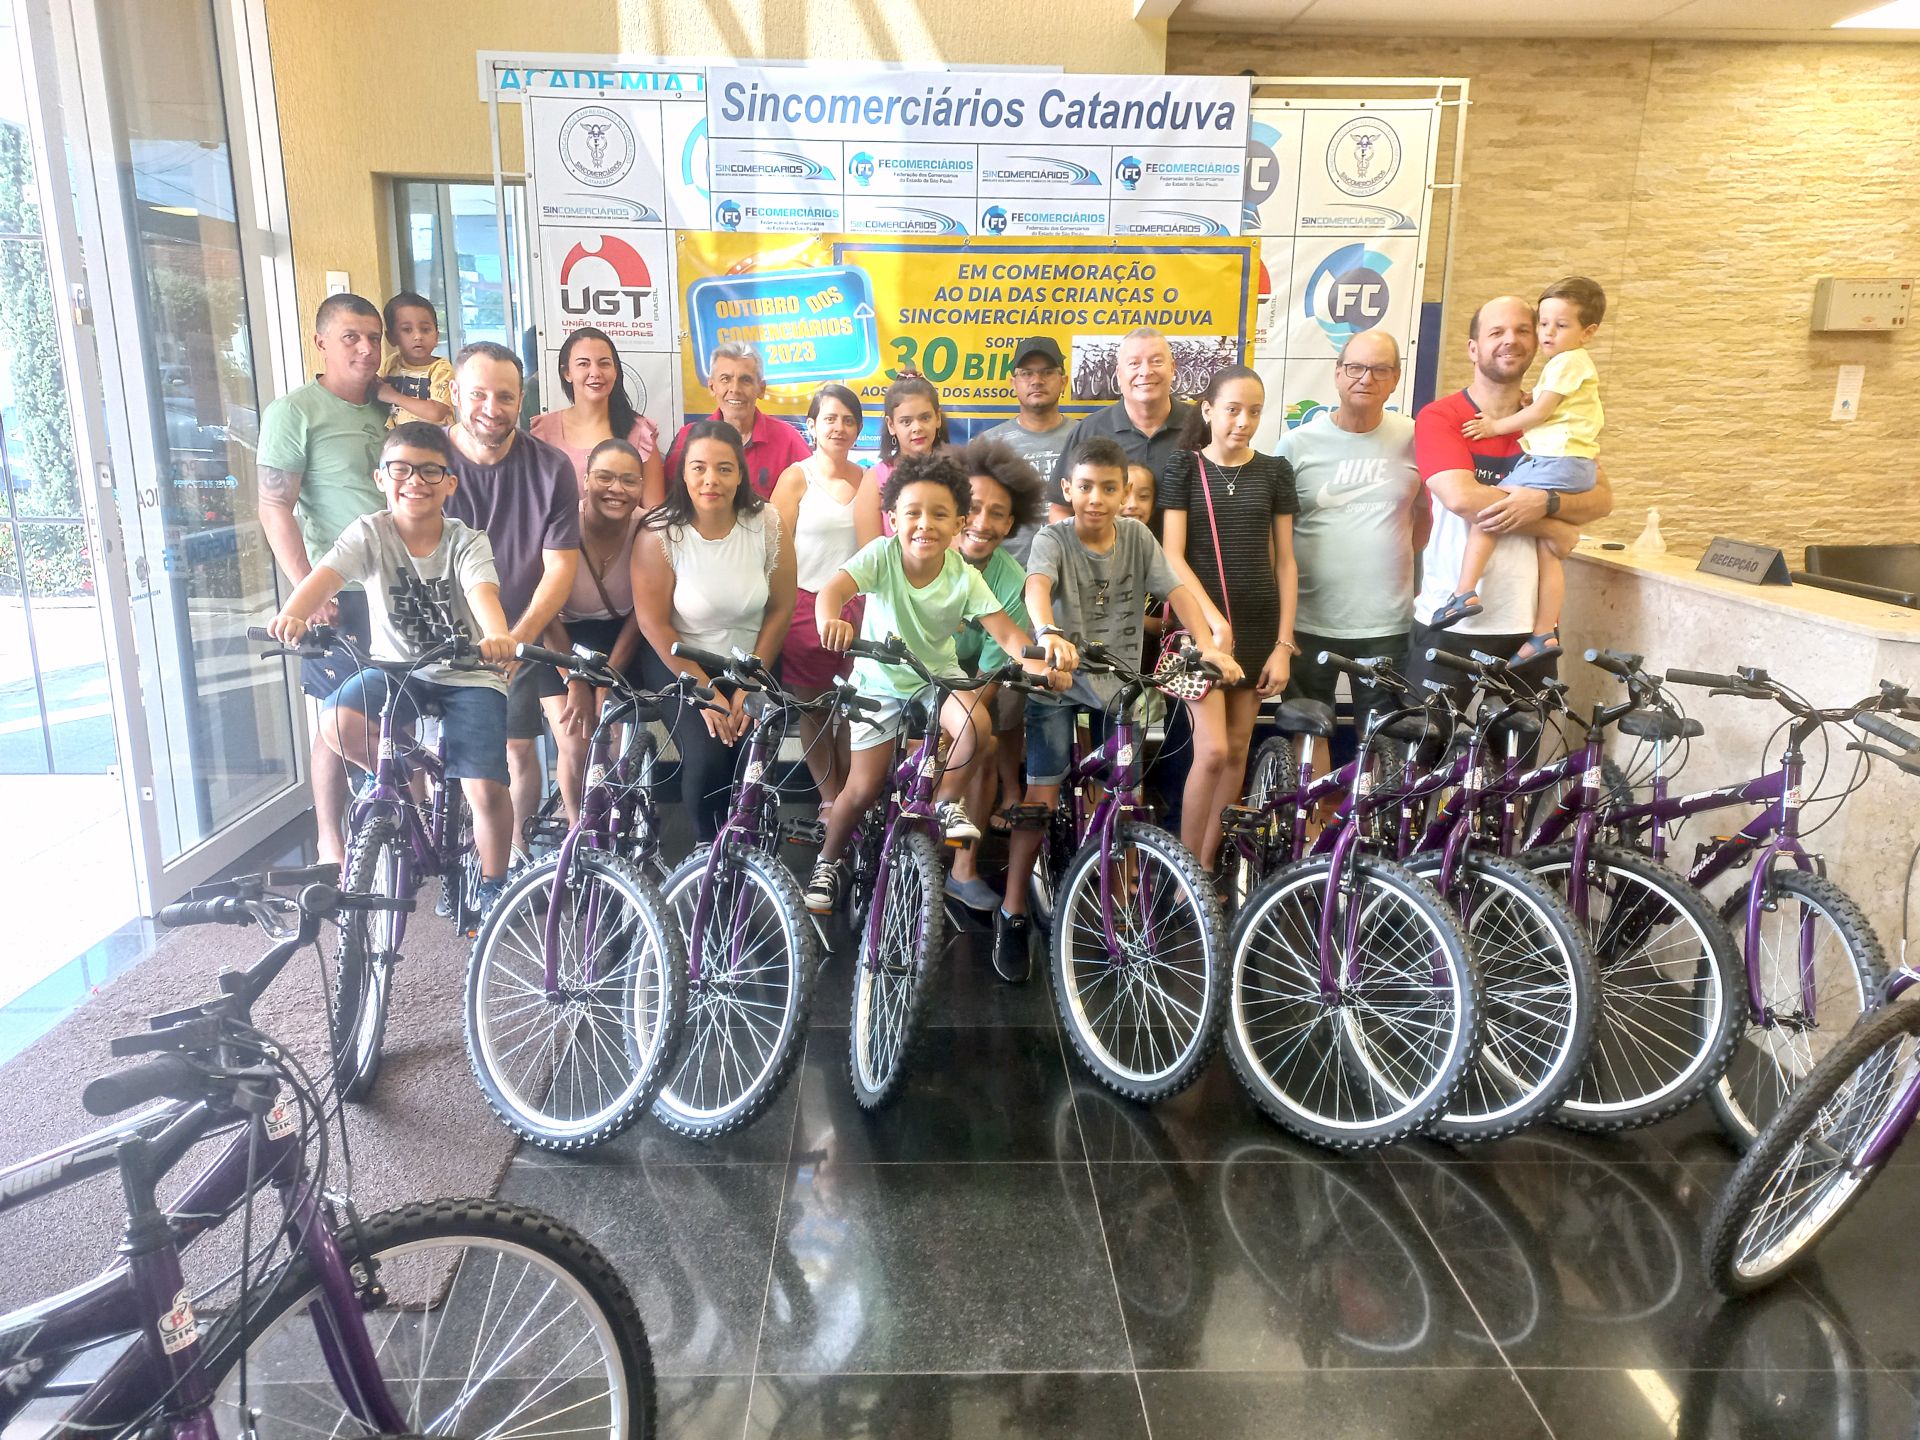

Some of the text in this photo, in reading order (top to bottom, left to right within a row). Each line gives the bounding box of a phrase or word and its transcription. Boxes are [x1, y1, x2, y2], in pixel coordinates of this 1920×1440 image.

[501, 69, 683, 91] ACADEMIA
[721, 81, 1025, 129] Sincomerciários
[1038, 88, 1236, 132] Catanduva
[878, 158, 974, 170] FECOMERCIÁRIOS
[982, 169, 1070, 180] SINCOMERCIÁRIOS
[1145, 162, 1240, 174] FECOMERCIÁRIOS
[745, 205, 840, 218] FECOMERCIÁRIOS
[1011, 211, 1105, 223] FECOMERCIÁRIOS
[958, 261, 1157, 285] EM COMEMORAÇÃO
[560, 285, 652, 320] UGT
[652, 287, 660, 322] BRASIL
[715, 285, 844, 319] OUTUBRO DOS
[933, 286, 1179, 306] AO DIA DAS CRIANÇAS O
[1335, 283, 1382, 317] FC
[561, 318, 592, 328] UNIÃO
[631, 321, 653, 329] DOS
[898, 305, 1214, 326] SINCOMERCIÁRIOS CATANDUVA
[716, 316, 854, 345] COMERCIÁRIOS
[765, 341, 817, 365] 2023
[884, 335, 1018, 384] 30 BIK
[942, 387, 970, 398] DOS
[973, 387, 1019, 399] ASSOC
[1333, 458, 1388, 485] NIKE
[1710, 553, 1760, 573] RECEPÇÃO
